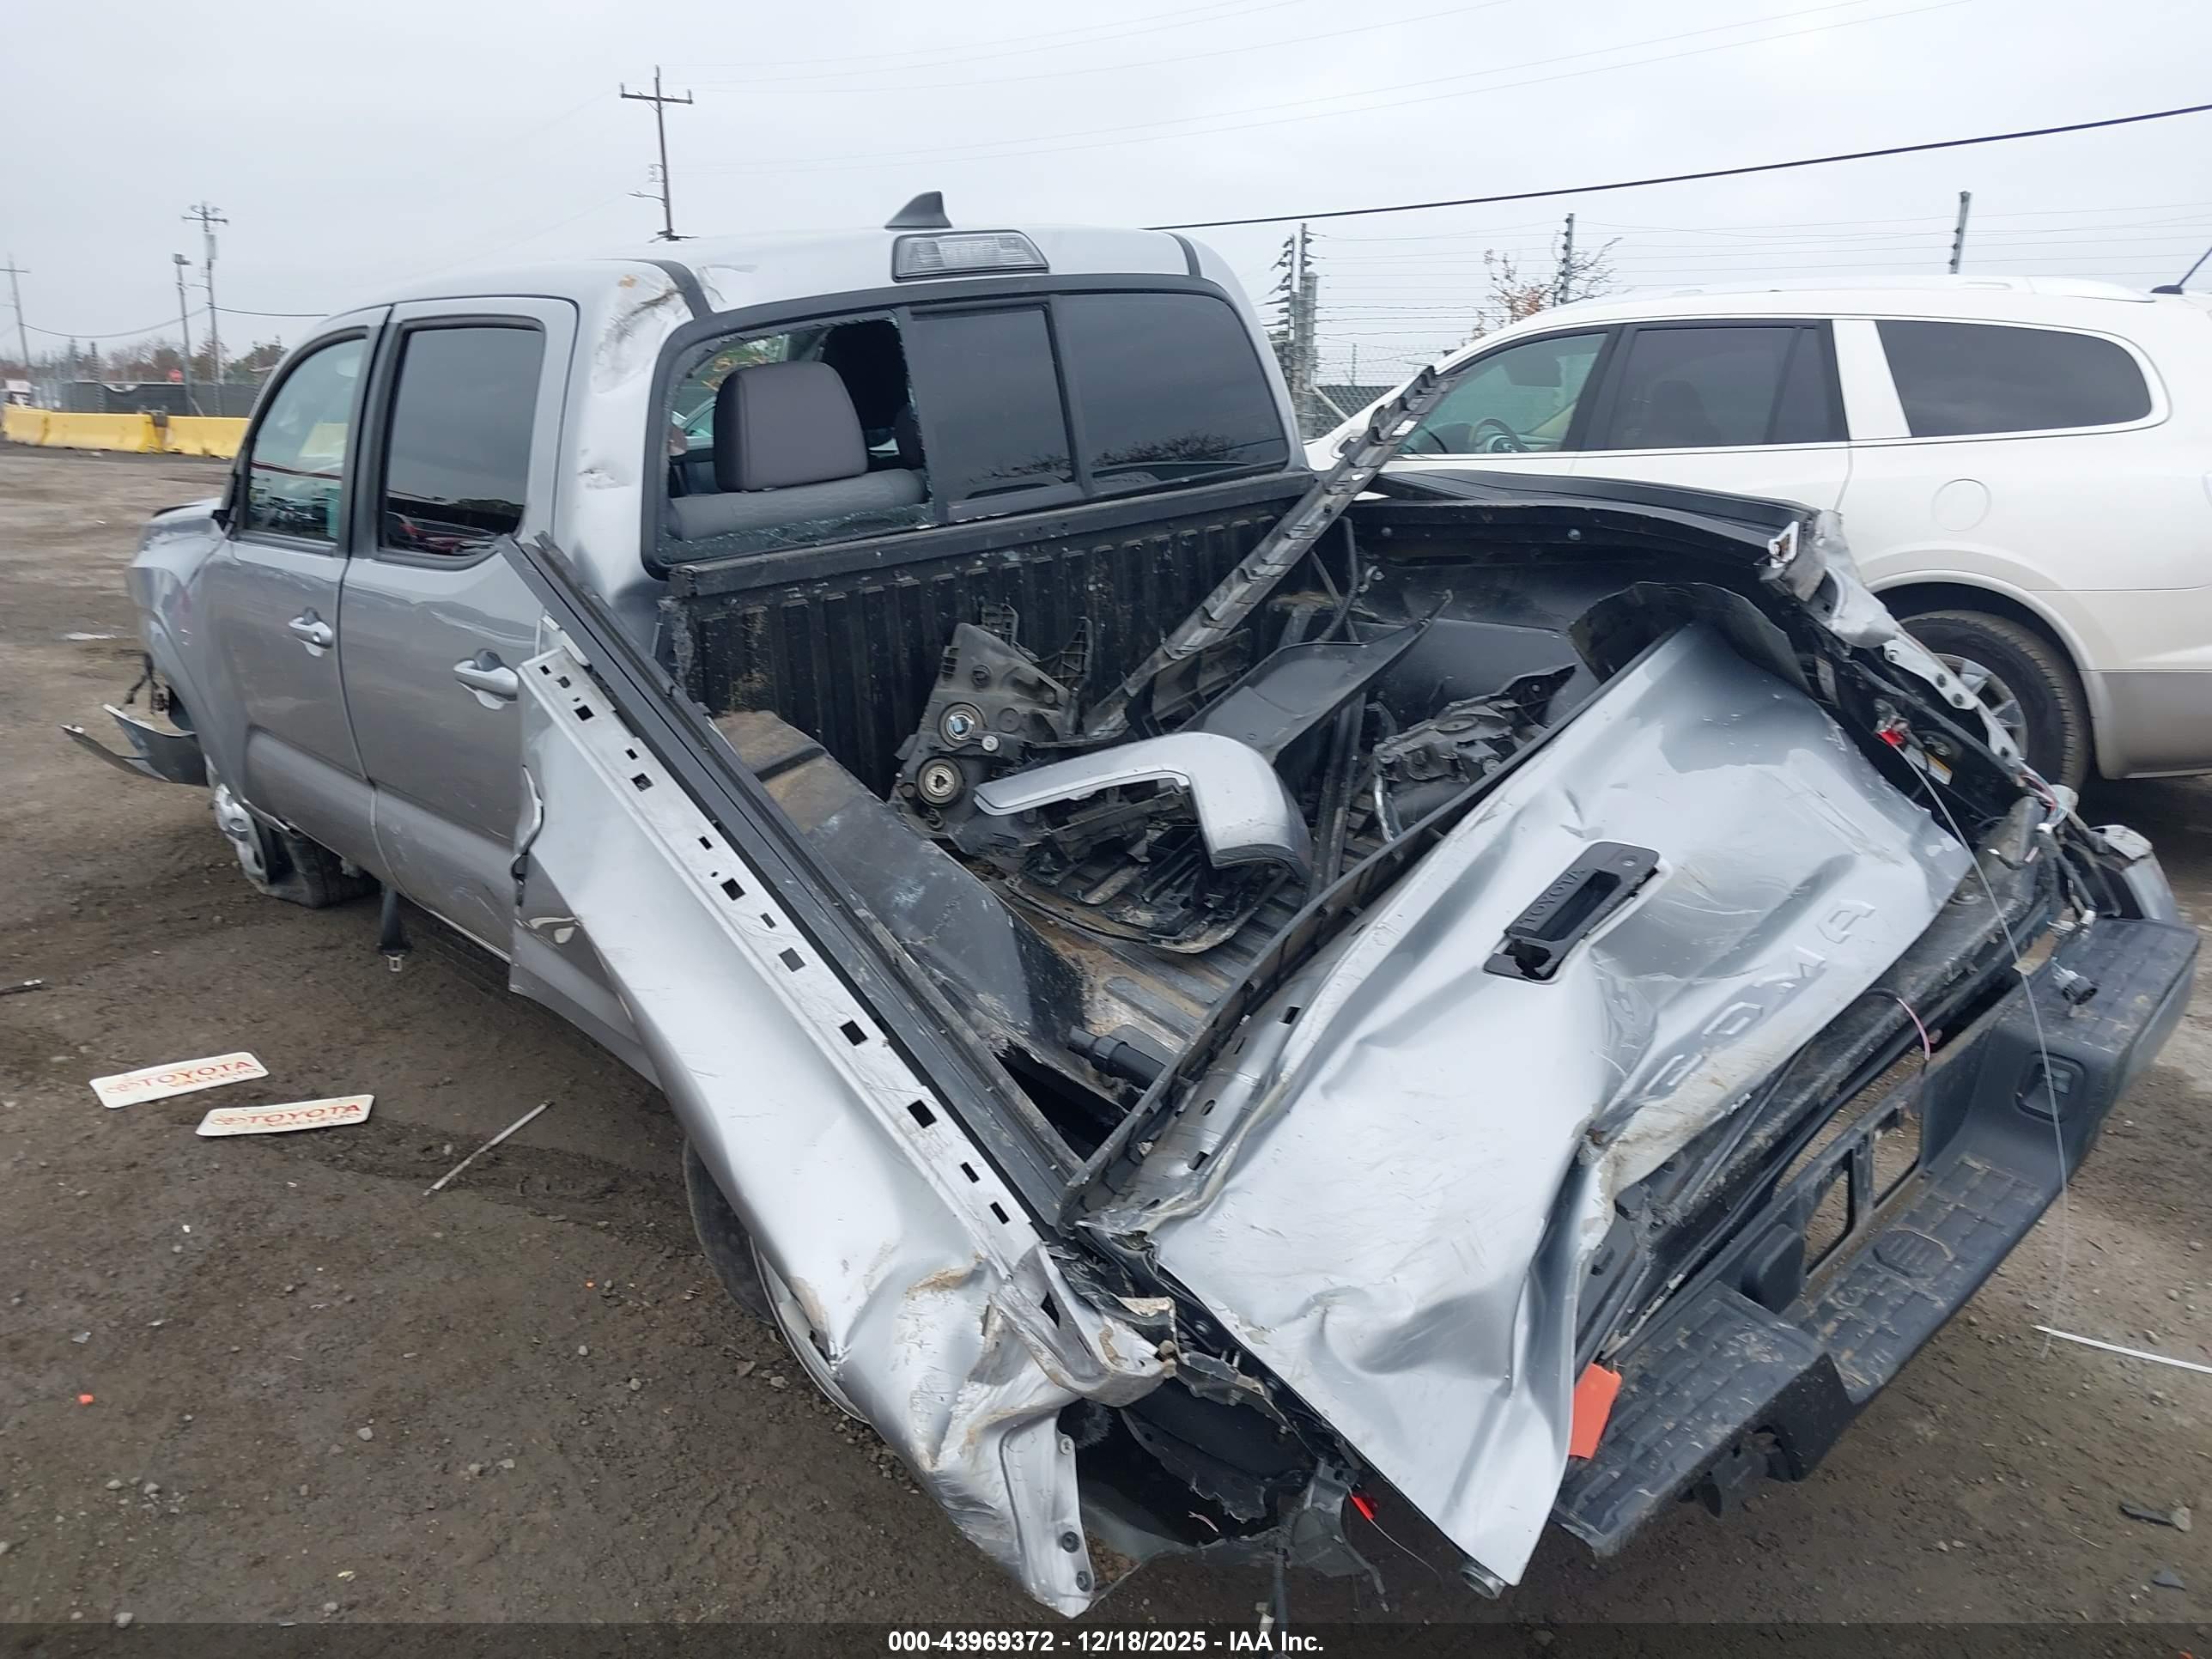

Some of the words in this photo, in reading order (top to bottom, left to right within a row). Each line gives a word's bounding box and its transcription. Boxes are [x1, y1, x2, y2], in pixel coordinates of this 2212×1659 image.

[1517, 868, 1587, 925] TOYOTA
[142, 1060, 254, 1087] TOYOTA
[247, 1104, 362, 1123] TOYOTA
